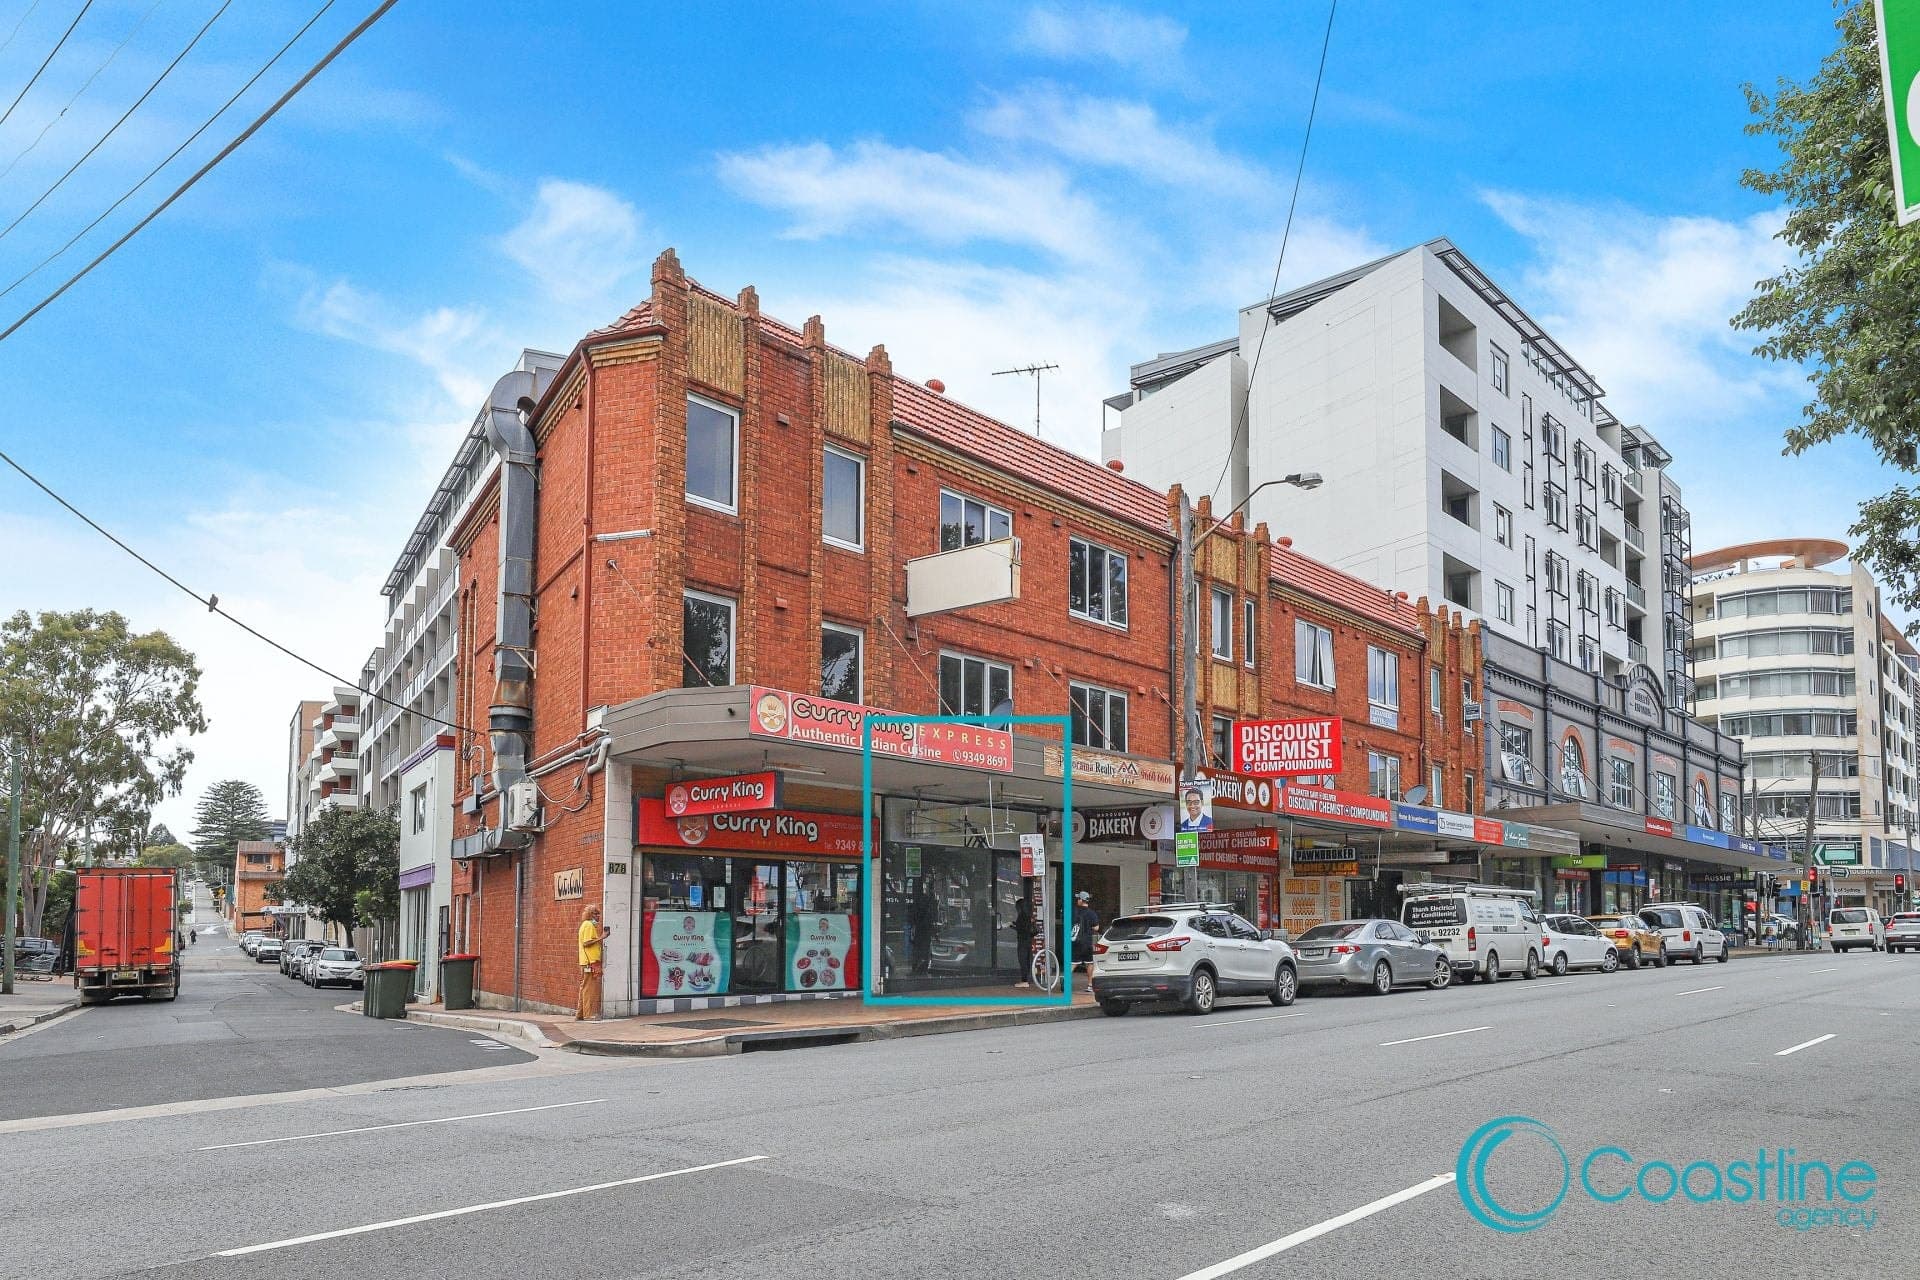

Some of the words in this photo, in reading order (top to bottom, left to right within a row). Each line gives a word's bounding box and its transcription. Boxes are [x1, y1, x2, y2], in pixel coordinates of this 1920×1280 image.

[792, 697, 861, 731] Curry
[792, 725, 857, 746] Authentic
[860, 734, 898, 753] Idian
[919, 725, 1007, 750] EXPRESS
[1241, 721, 1332, 743] DISCOUNT
[1242, 739, 1332, 762] CHEMIST
[962, 750, 985, 764] 9349
[986, 754, 1008, 768] 8691
[1254, 758, 1333, 772] COMPOUNDING
[1095, 761, 1116, 777] Realty
[691, 785, 729, 802] Curry
[732, 781, 764, 800] King
[1210, 776, 1243, 803] BAKERY
[1289, 795, 1317, 812] DISCOUNT
[1319, 801, 1344, 816] CHEMIST
[1350, 806, 1388, 823] COMPOUNDING
[712, 813, 771, 837] Curry
[776, 815, 818, 842] King
[1089, 815, 1137, 839] BAKERY
[835, 839, 856, 850] 9349
[1200, 839, 1229, 850] COUNT
[1231, 836, 1271, 848] CHEMIST
[1216, 852, 1238, 864] CHEMIST
[1296, 849, 1354, 861] PAWNBROKER
[608, 863, 627, 874] 878
[1704, 874, 1731, 882] Aussie
[1421, 910, 1457, 918] Conditioning
[1430, 903, 1457, 912] Electrical
[673, 934, 689, 943] Curry
[690, 934, 704, 943] King
[825, 934, 837, 943] King
[1438, 927, 1461, 937] 92232
